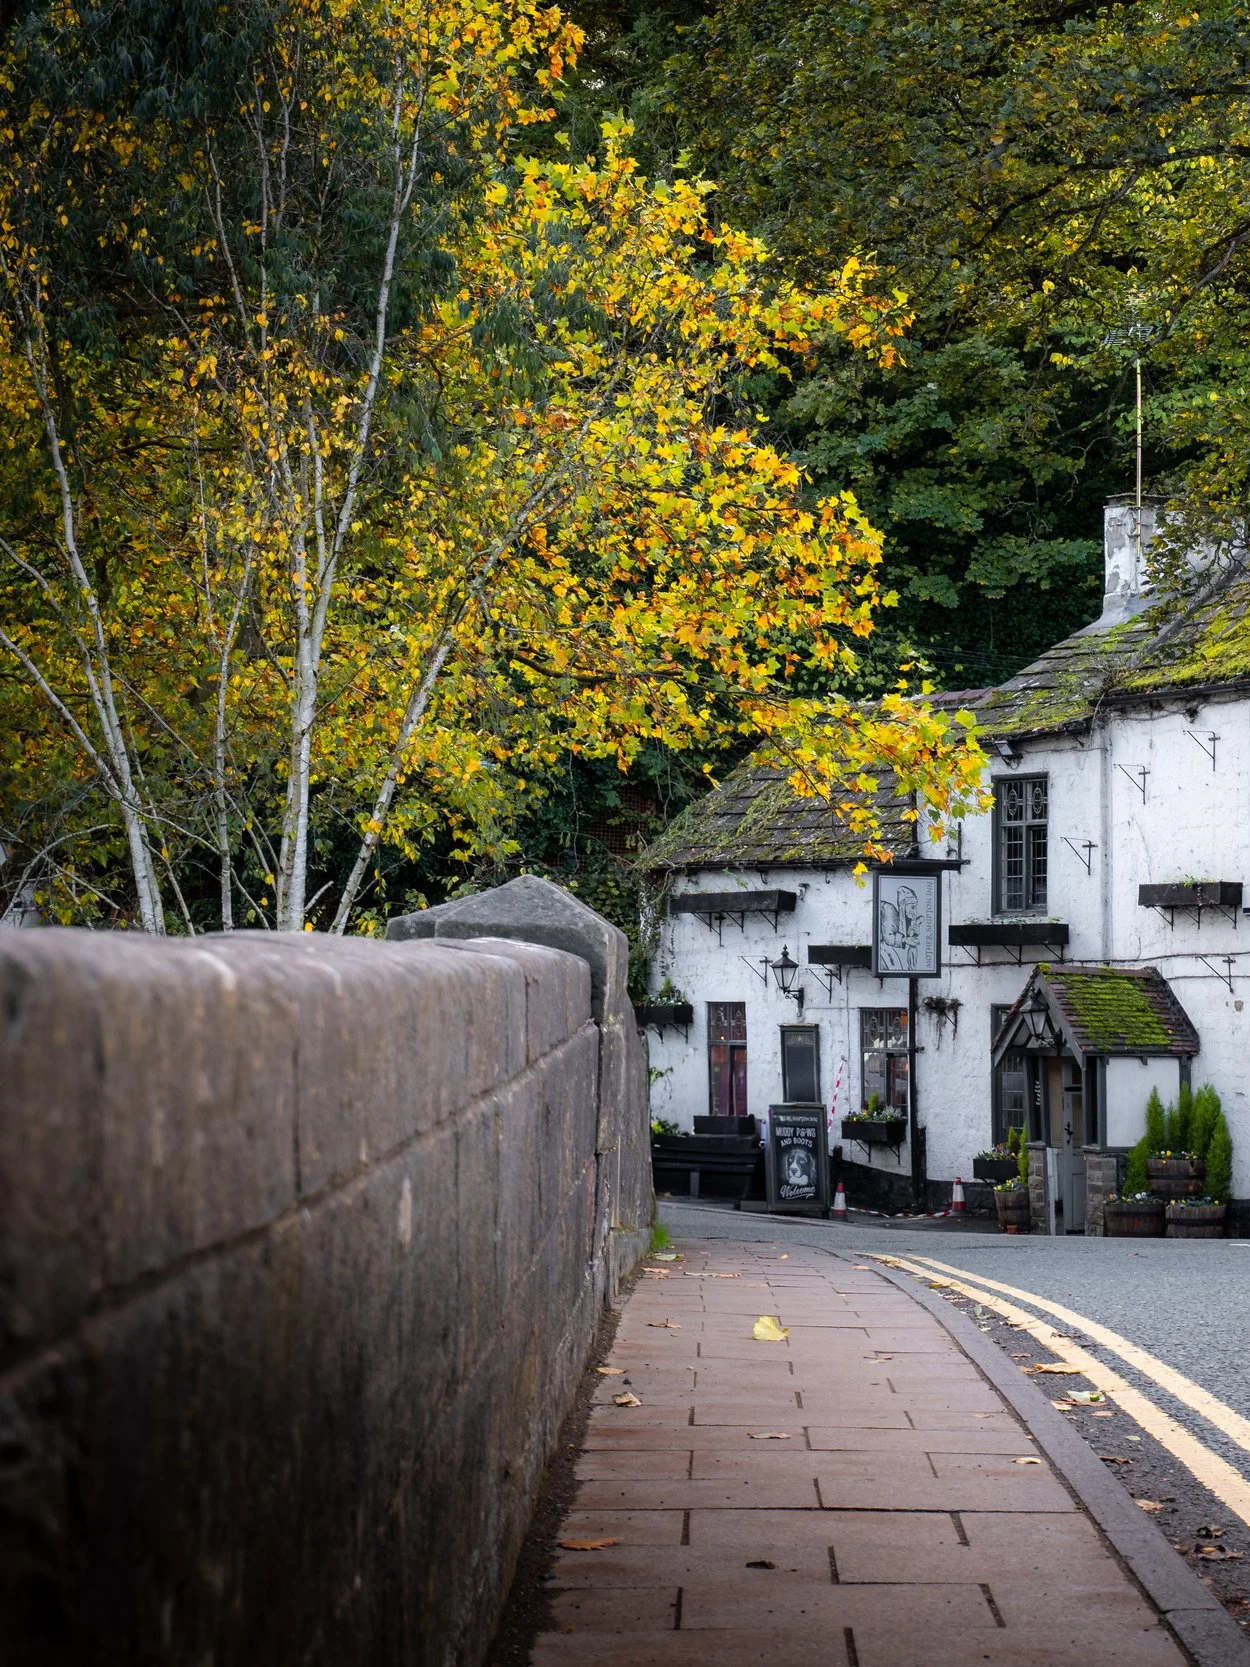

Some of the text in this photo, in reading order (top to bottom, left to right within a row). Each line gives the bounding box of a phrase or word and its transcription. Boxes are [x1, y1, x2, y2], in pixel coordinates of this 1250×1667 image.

[925, 881, 933, 968] MOTHER SHIPTON INN
[775, 1127, 794, 1137] MUDDY
[781, 1137, 813, 1147] AND BOOTS
[780, 1185, 815, 1198] Welcome
